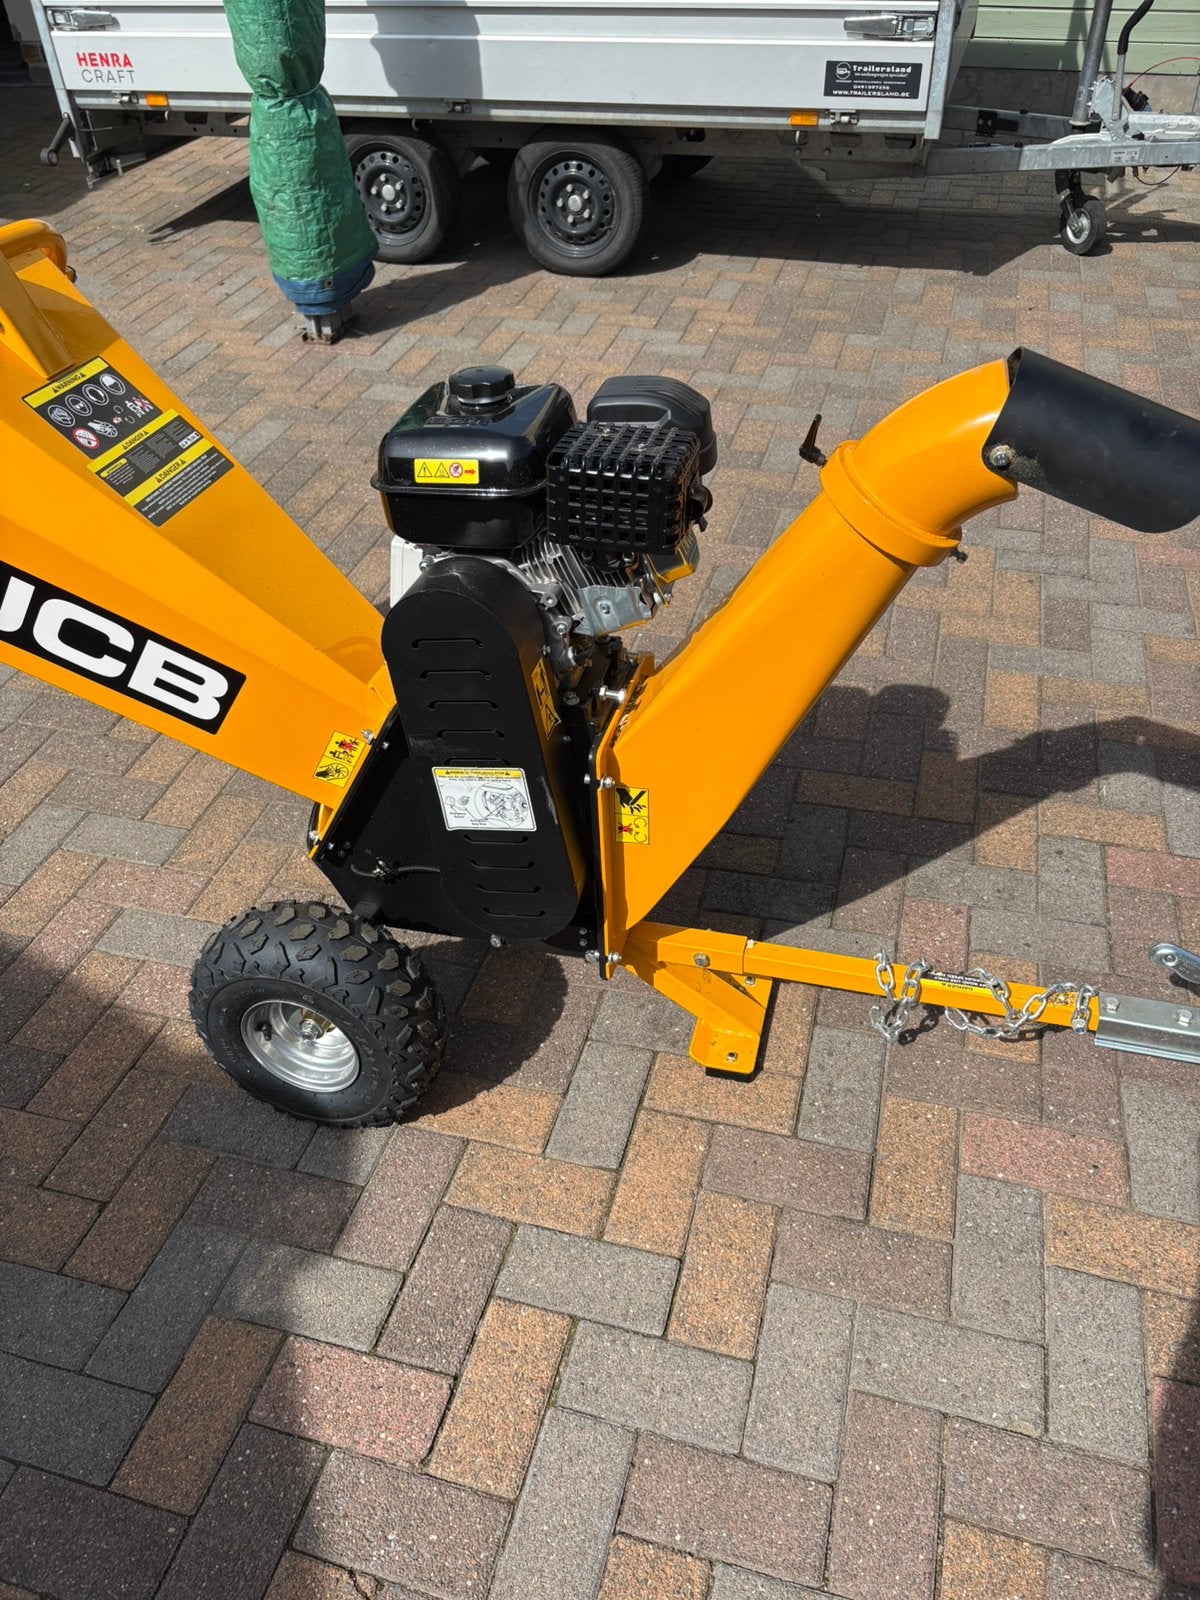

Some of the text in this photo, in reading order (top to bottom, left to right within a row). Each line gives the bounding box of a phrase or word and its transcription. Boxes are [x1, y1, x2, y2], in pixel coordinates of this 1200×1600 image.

[76, 52, 133, 68] HENRA
[81, 68, 135, 84] CRAFT
[852, 65, 912, 74] Trailersland
[125, 433, 145, 448] DANGER
[160, 461, 183, 481] DANGER
[0, 576, 229, 721] JCB
